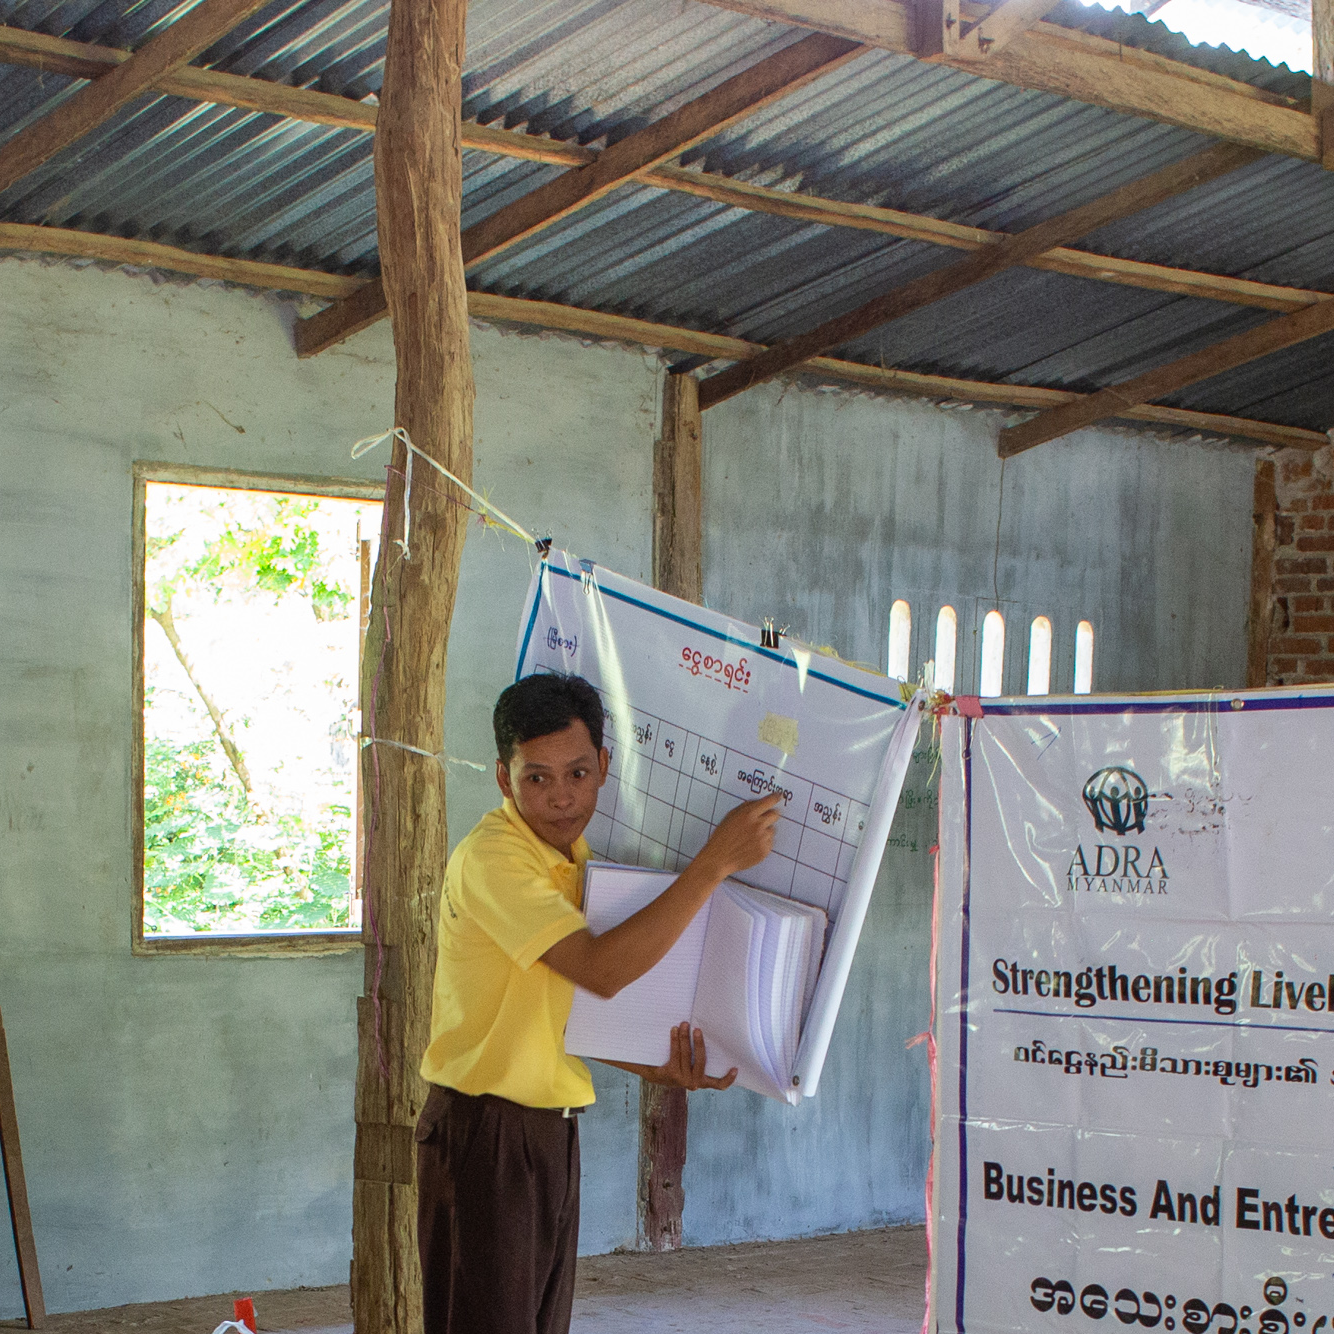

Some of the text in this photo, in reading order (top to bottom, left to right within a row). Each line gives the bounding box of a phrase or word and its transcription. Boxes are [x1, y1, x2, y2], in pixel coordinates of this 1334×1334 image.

[1066, 844, 1169, 879] ADRA
[1066, 878, 1168, 895] MYANMAR
[992, 958, 1238, 1014] Strengthening
[983, 1161, 1138, 1217] Business
[1149, 1179, 1221, 1227] And
